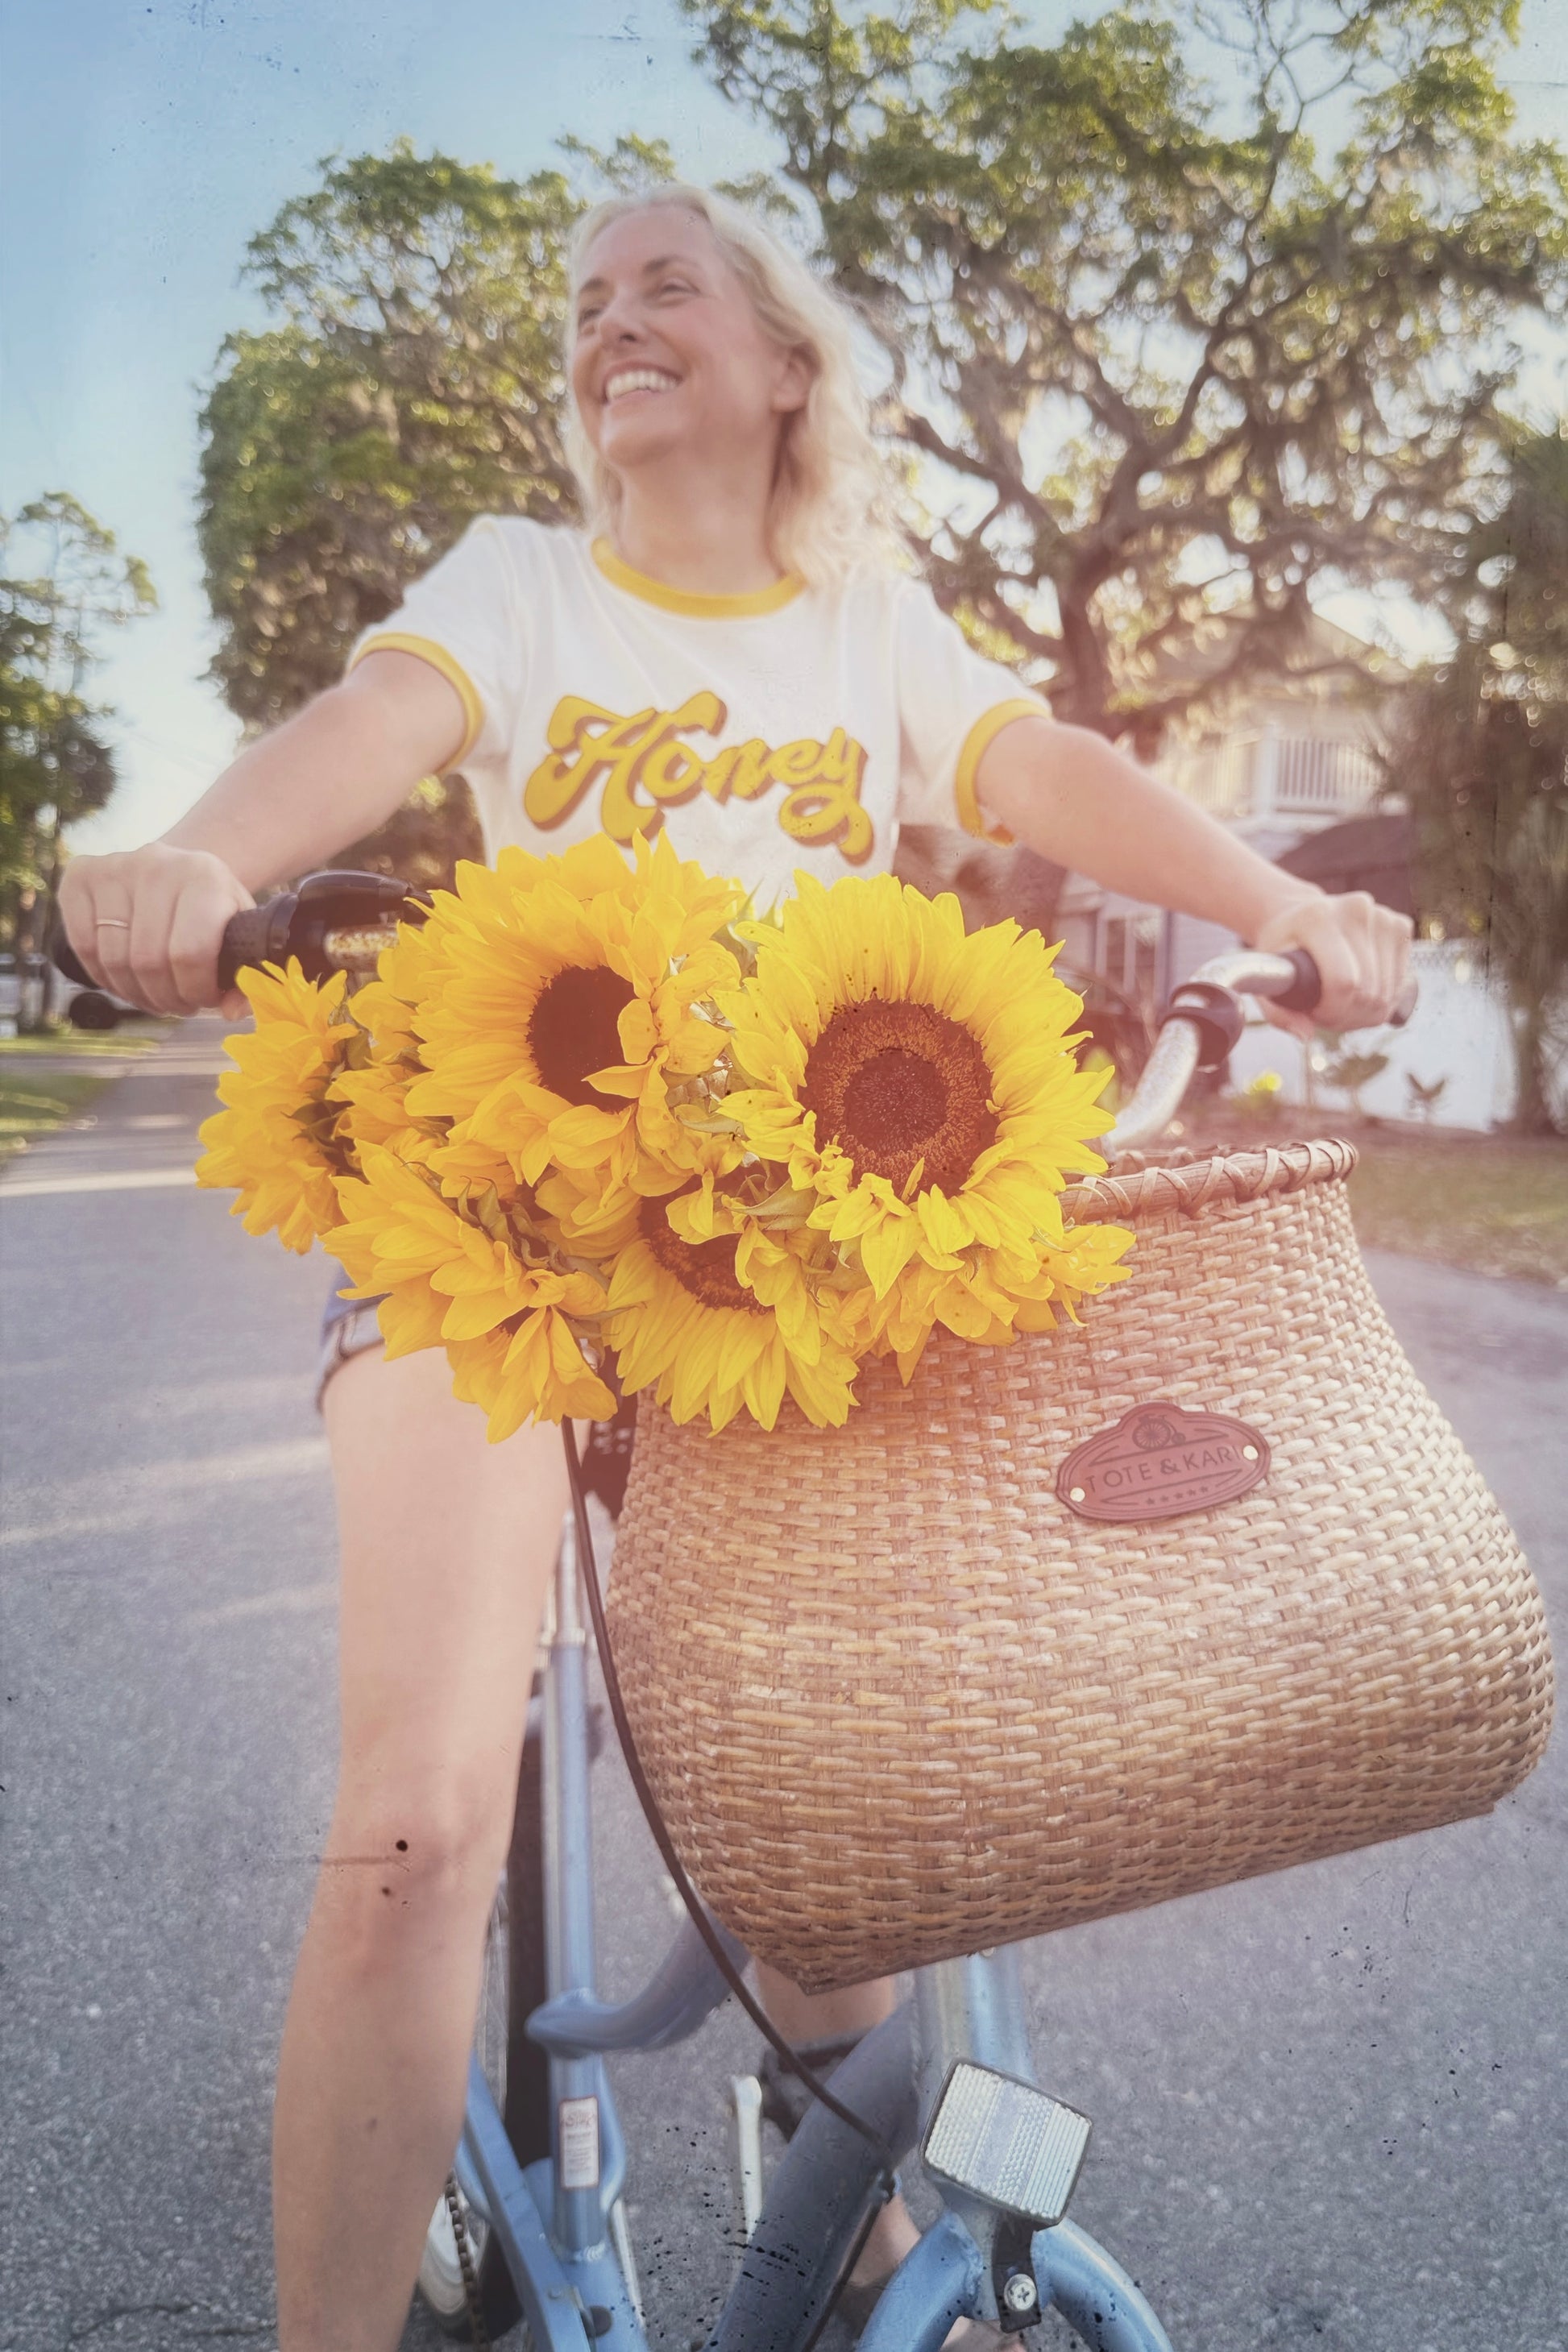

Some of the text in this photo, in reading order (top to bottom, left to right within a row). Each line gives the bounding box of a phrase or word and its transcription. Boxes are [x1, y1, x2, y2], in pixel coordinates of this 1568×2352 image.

[525, 691, 874, 866] Honey
[1085, 1445, 1241, 1493] TOTE & KARI
